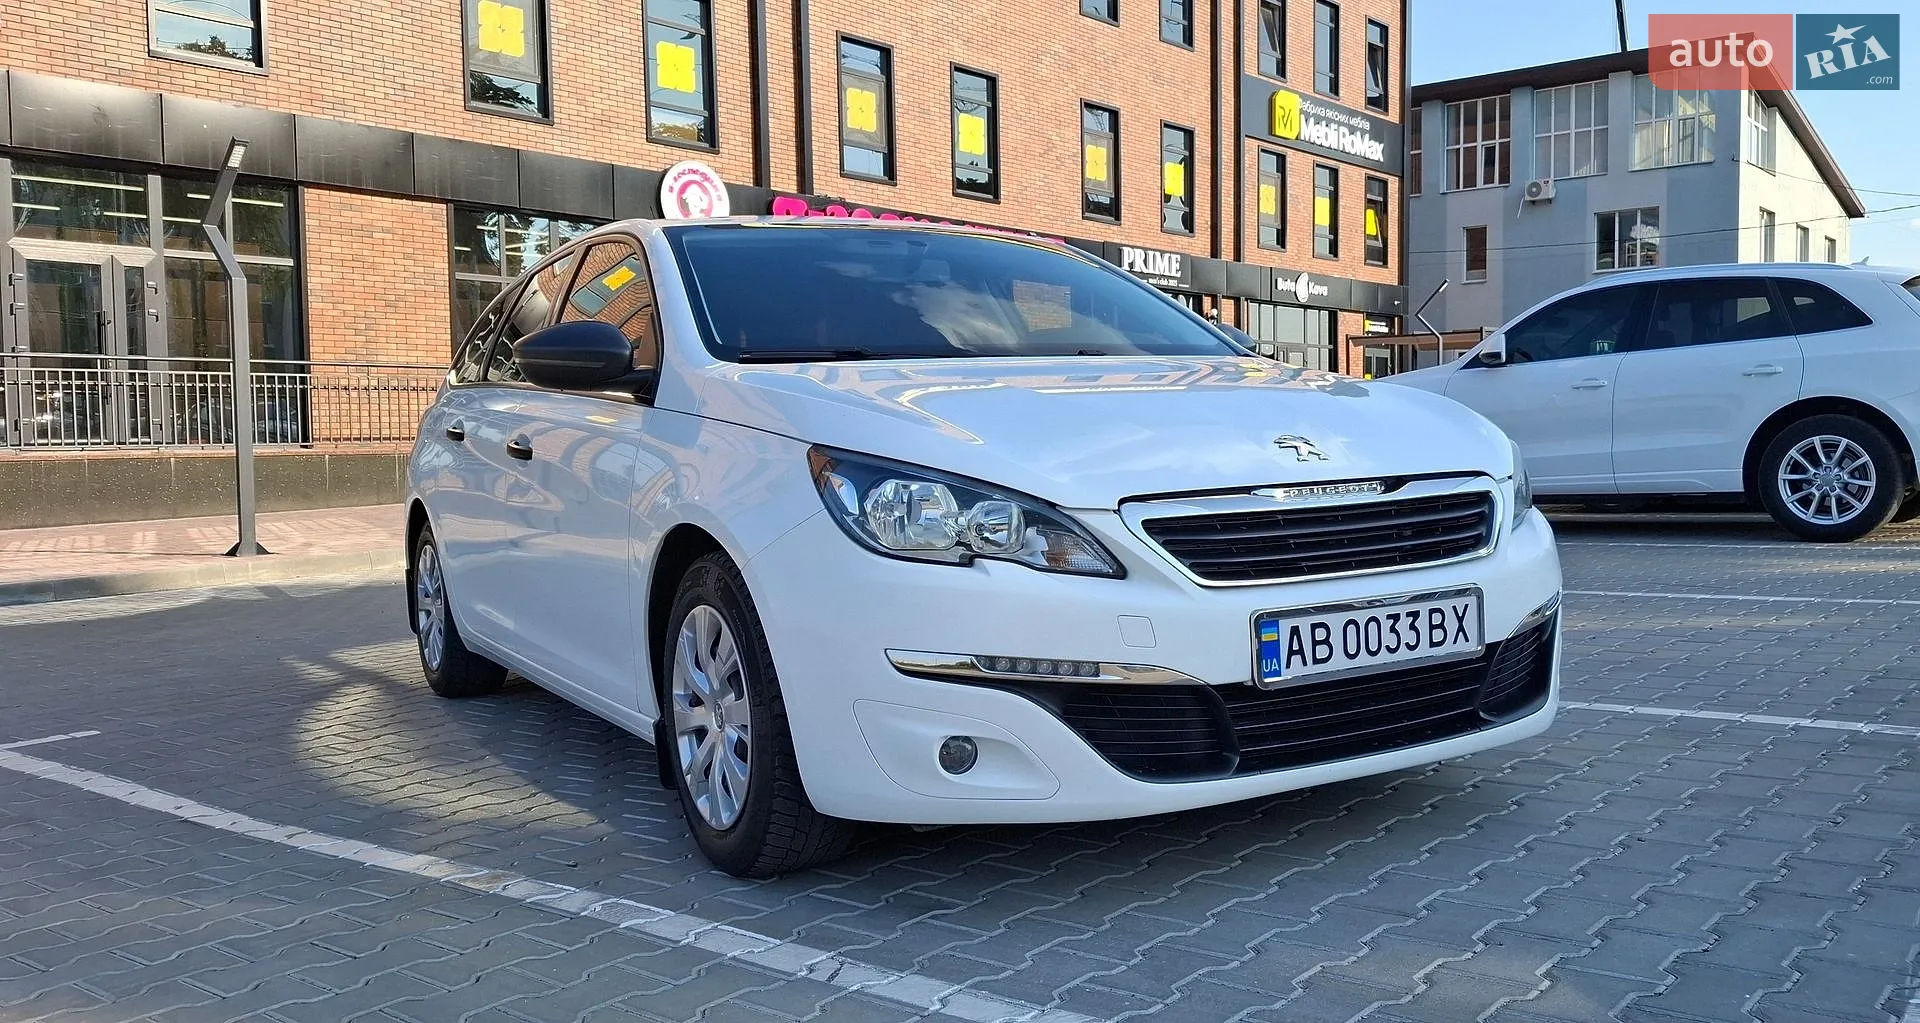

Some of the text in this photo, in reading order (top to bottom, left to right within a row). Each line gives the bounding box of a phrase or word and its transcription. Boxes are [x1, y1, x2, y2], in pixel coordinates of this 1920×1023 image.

[1300, 114, 1384, 162] Mebli RoMax
[1120, 246, 1182, 278] PRIME
[1289, 482, 1370, 498] PEUGEOT
[1286, 603, 1470, 669] AB 0033 BX
[1263, 657, 1280, 673] UA
